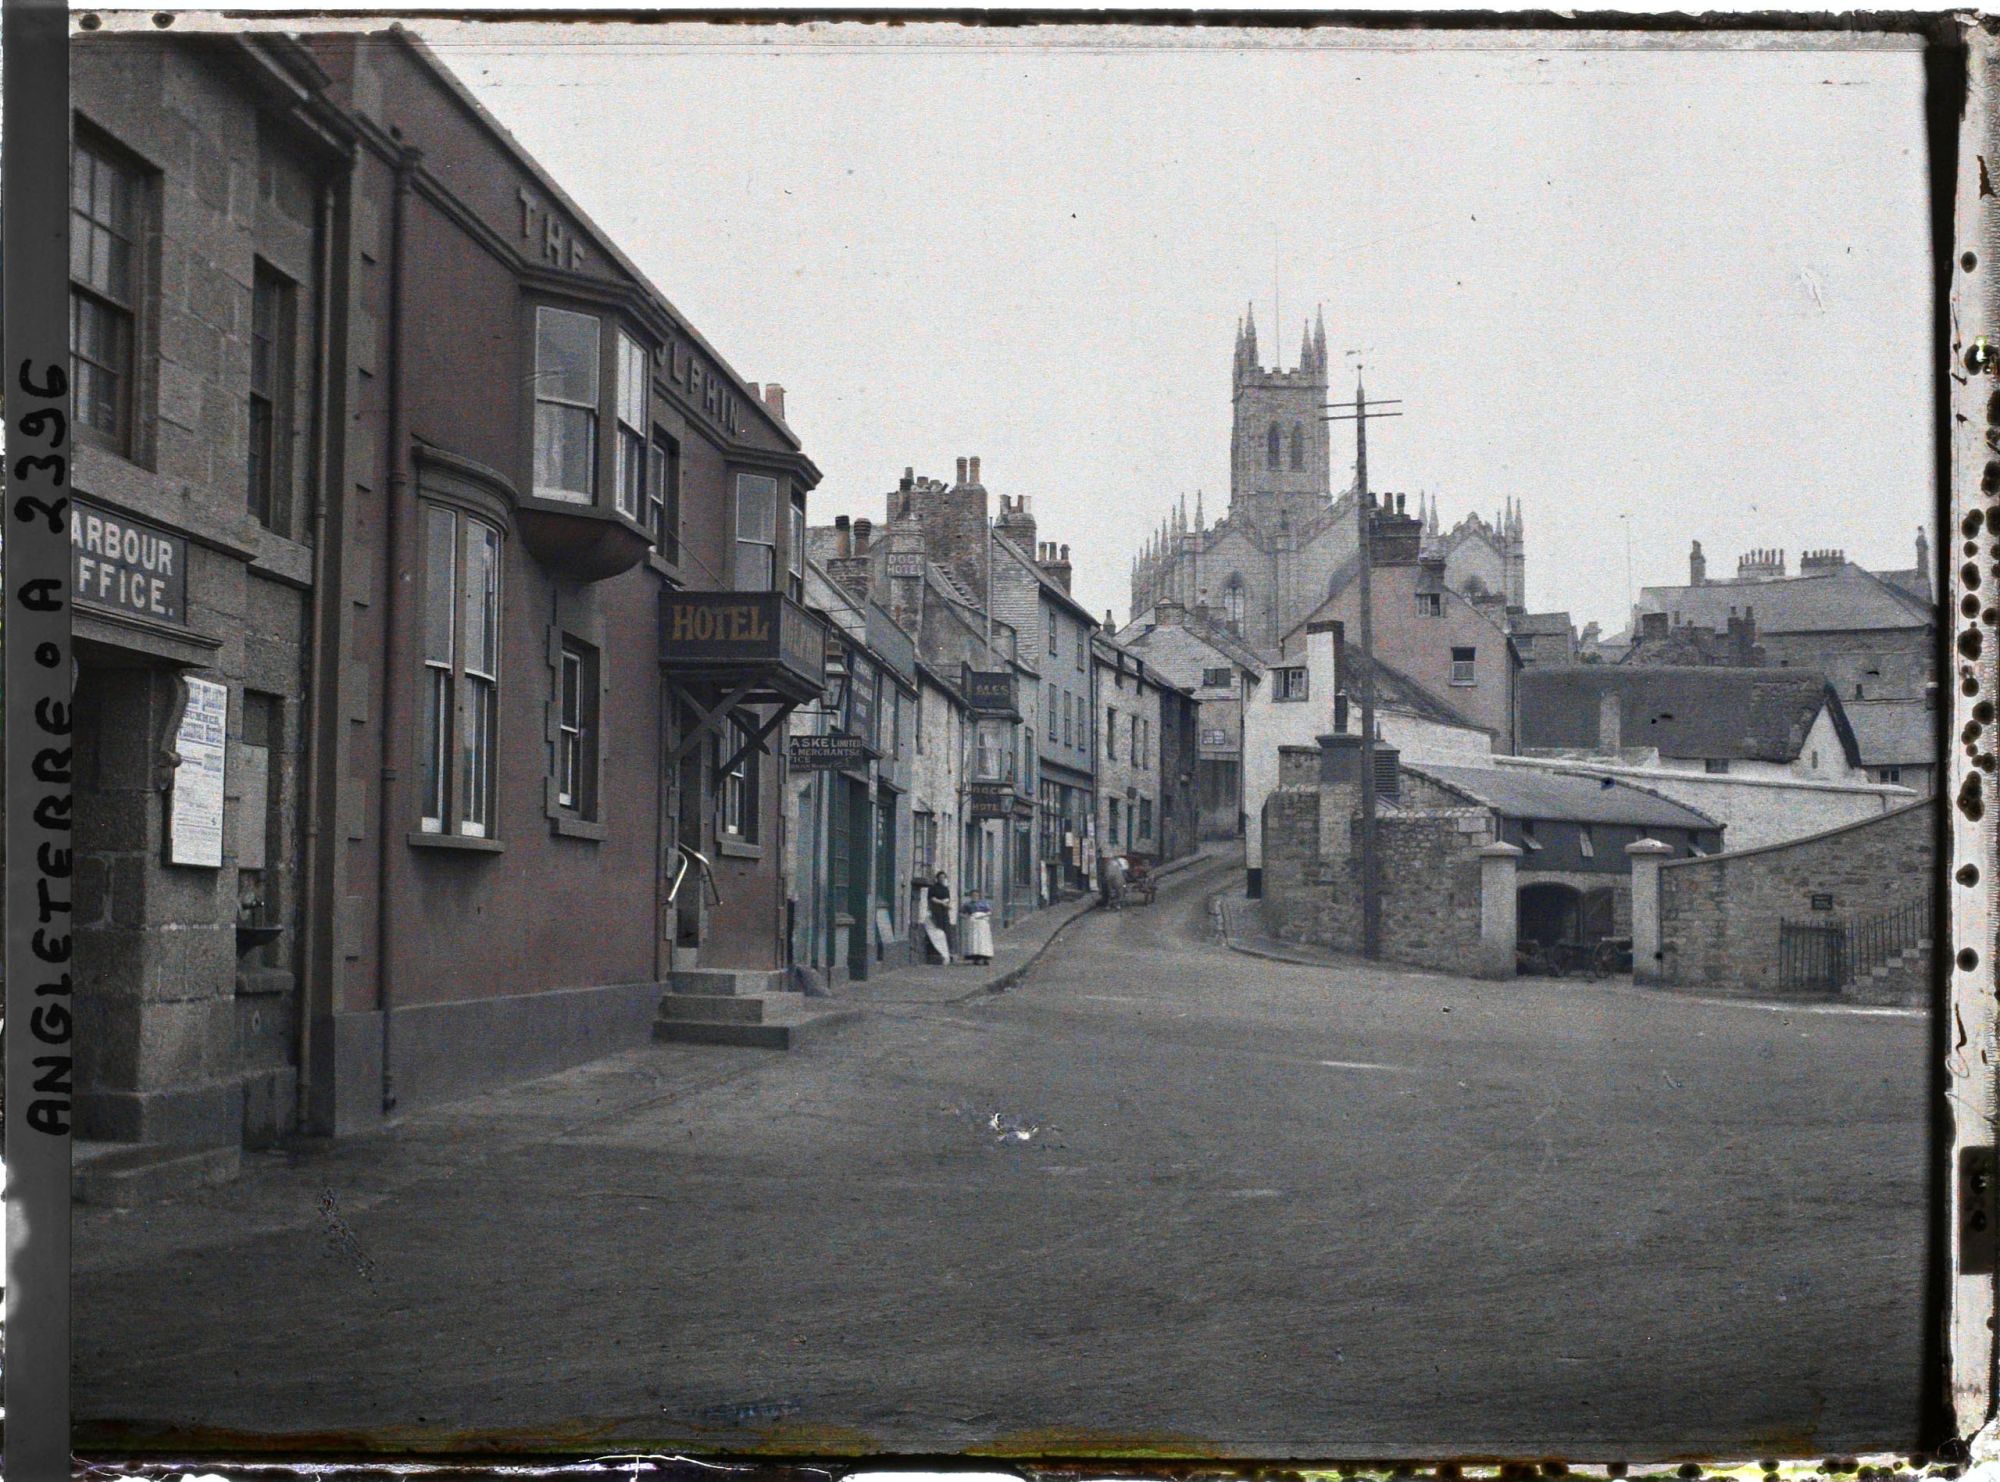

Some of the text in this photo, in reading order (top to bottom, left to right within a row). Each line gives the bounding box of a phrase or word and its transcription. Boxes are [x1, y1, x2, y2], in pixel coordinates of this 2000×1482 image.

[13, 359, 68, 534] 2396
[887, 564, 925, 576] HOTEL
[888, 554, 925, 565] DOCK
[17, 569, 62, 612] A
[671, 604, 770, 641] HOTEL
[27, 697, 73, 1136] ANGLETERRE
